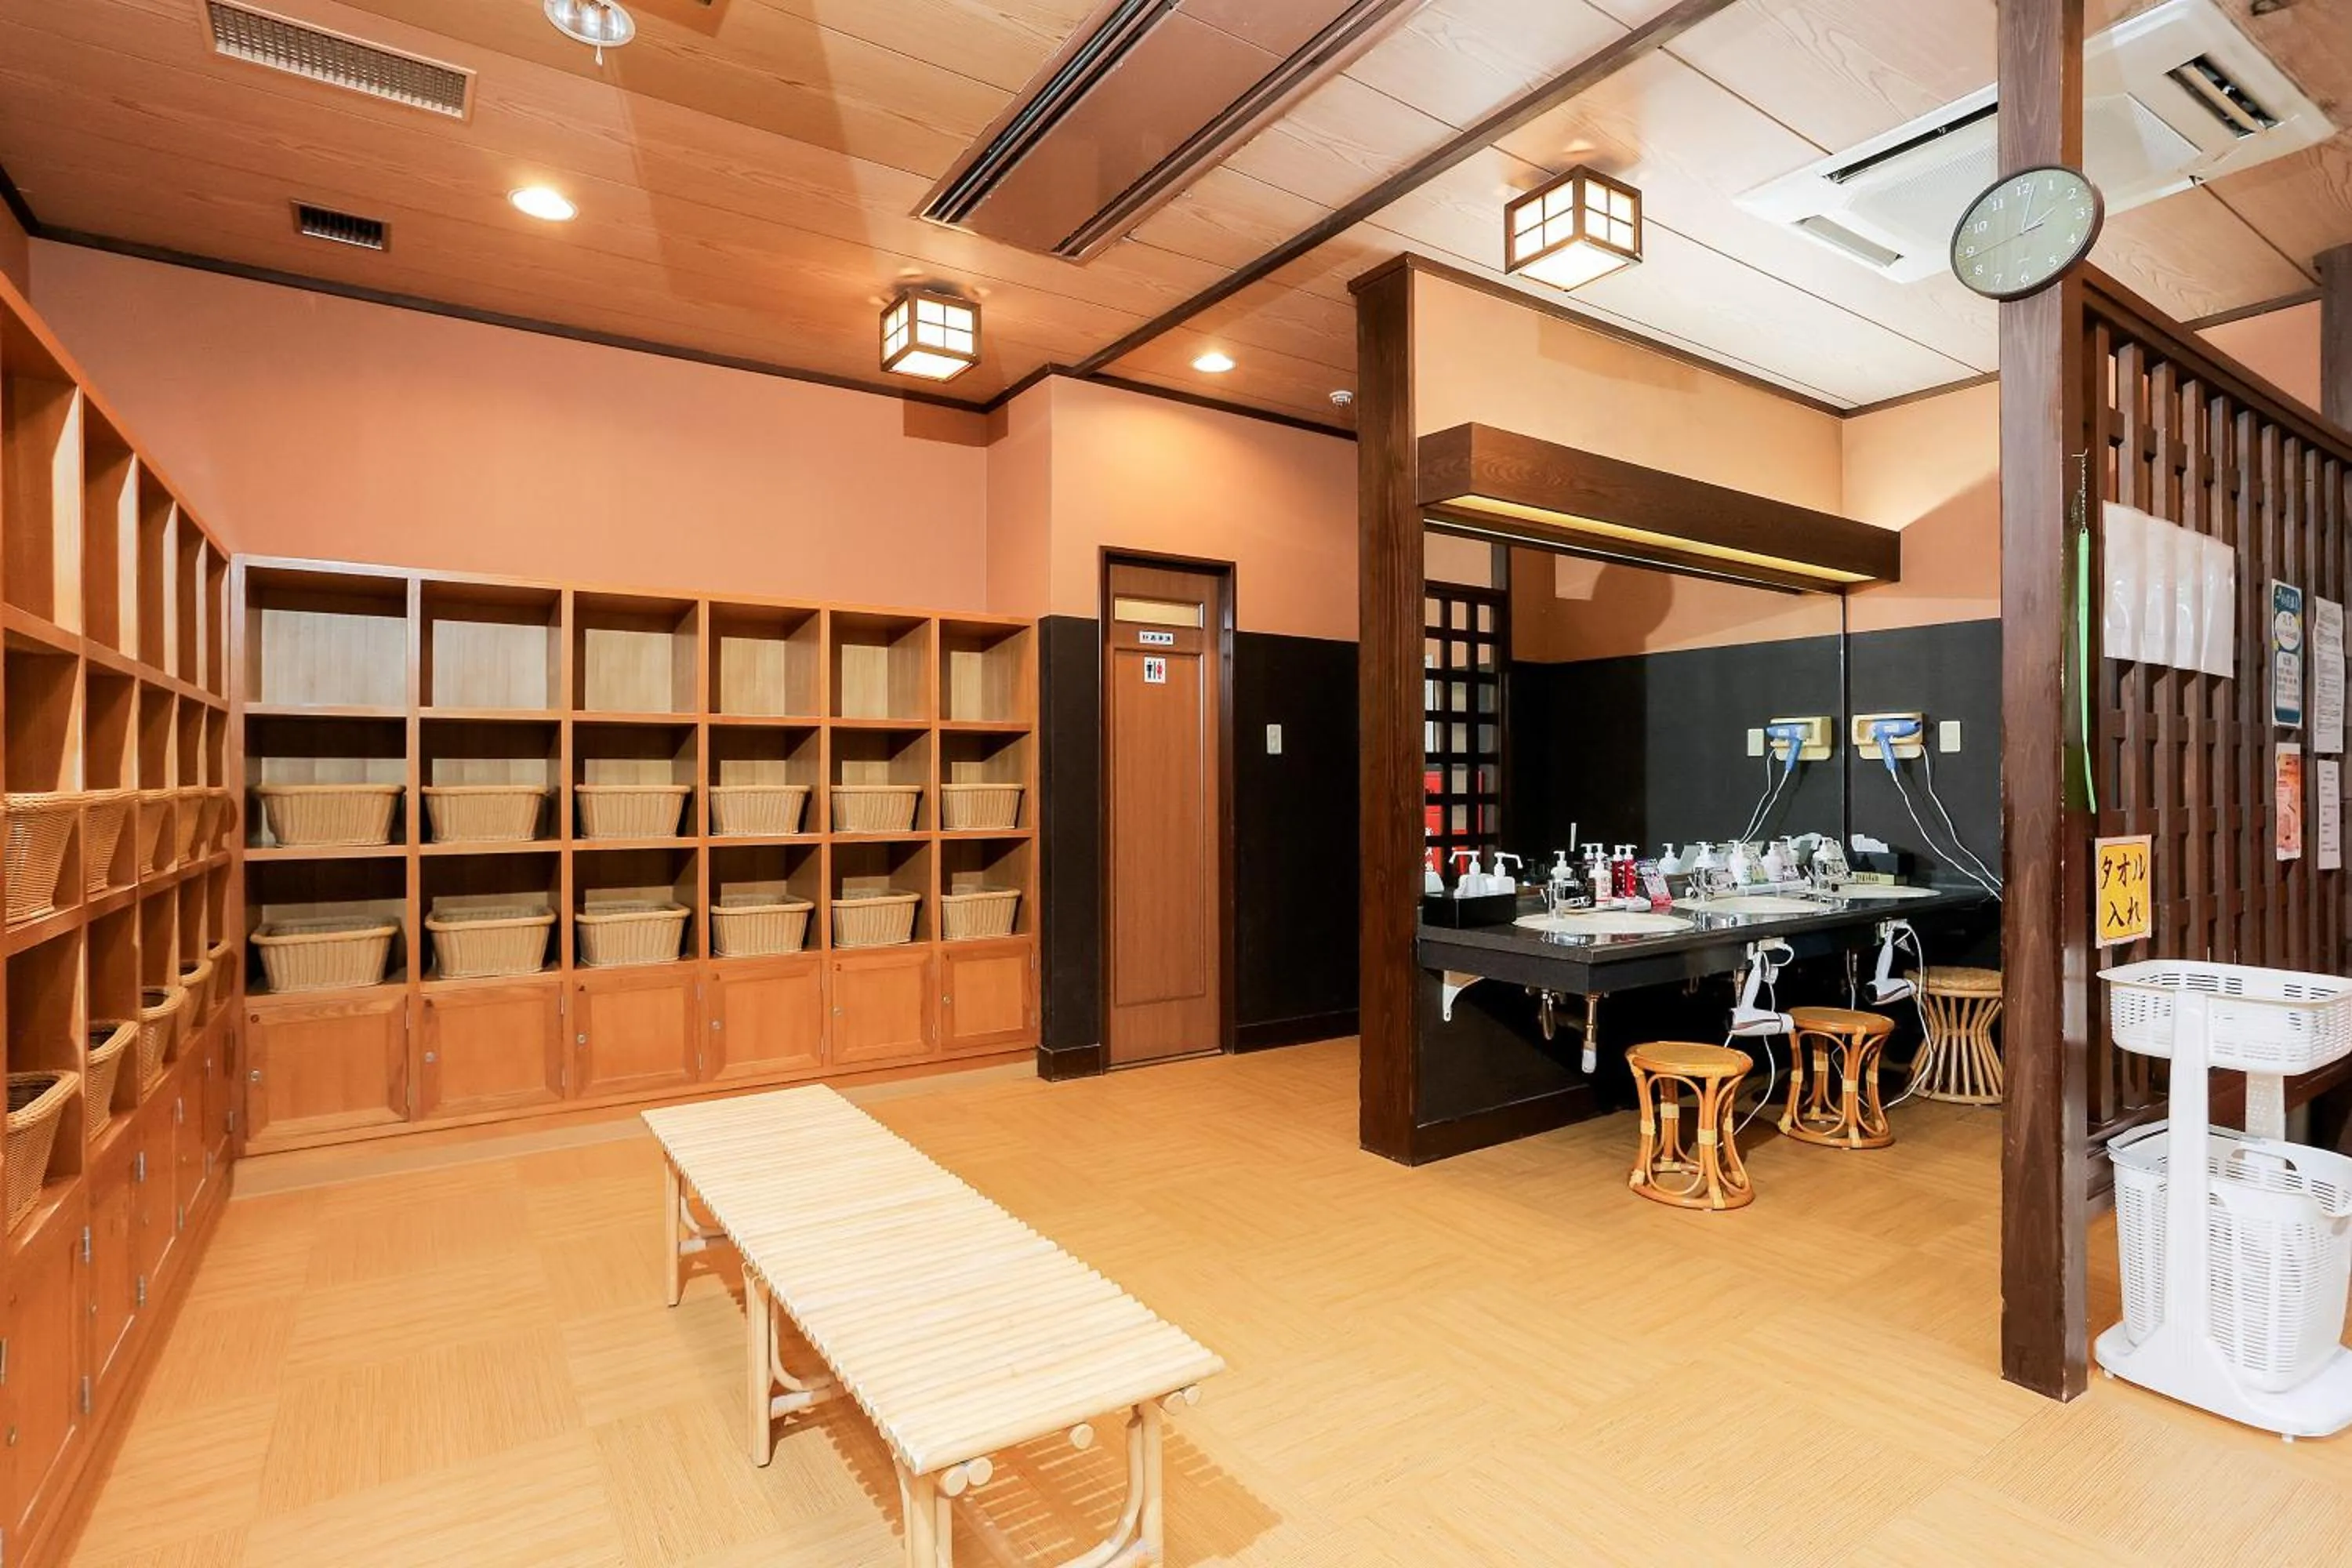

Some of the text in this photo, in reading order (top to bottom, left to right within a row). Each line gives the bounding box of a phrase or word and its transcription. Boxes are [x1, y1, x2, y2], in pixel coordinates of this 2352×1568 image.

[2016, 183, 2030, 196] 12
[2067, 187, 2077, 200] 2
[1992, 198, 2004, 212] 11
[1975, 220, 1987, 234] 10
[1975, 263, 1983, 275] 8
[1994, 273, 2002, 287] 7
[2101, 852, 2146, 889] タオル
[2107, 896, 2141, 927] 入れ
